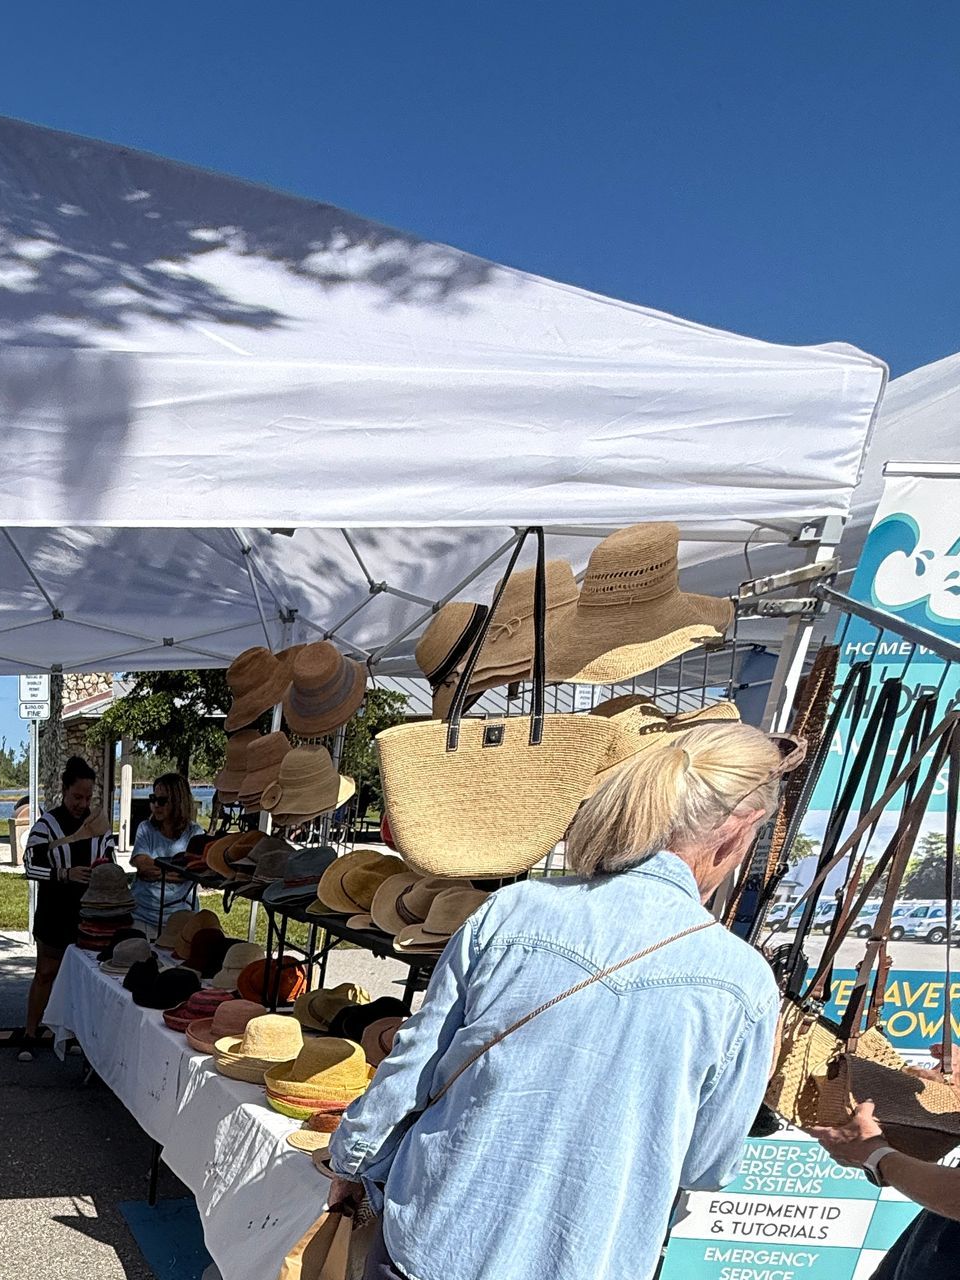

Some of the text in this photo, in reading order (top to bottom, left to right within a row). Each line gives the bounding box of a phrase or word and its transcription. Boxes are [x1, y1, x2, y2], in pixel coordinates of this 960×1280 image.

[845, 642, 913, 655] HOME
[862, 980, 945, 1008] AVE
[739, 1160, 782, 1176] ERSE
[743, 1176, 823, 1194] SYSTEMS
[709, 1200, 841, 1220] EQUIPMENT ID
[710, 1219, 829, 1240] & TUTORIALS
[703, 1247, 820, 1268] EMERGENCY
